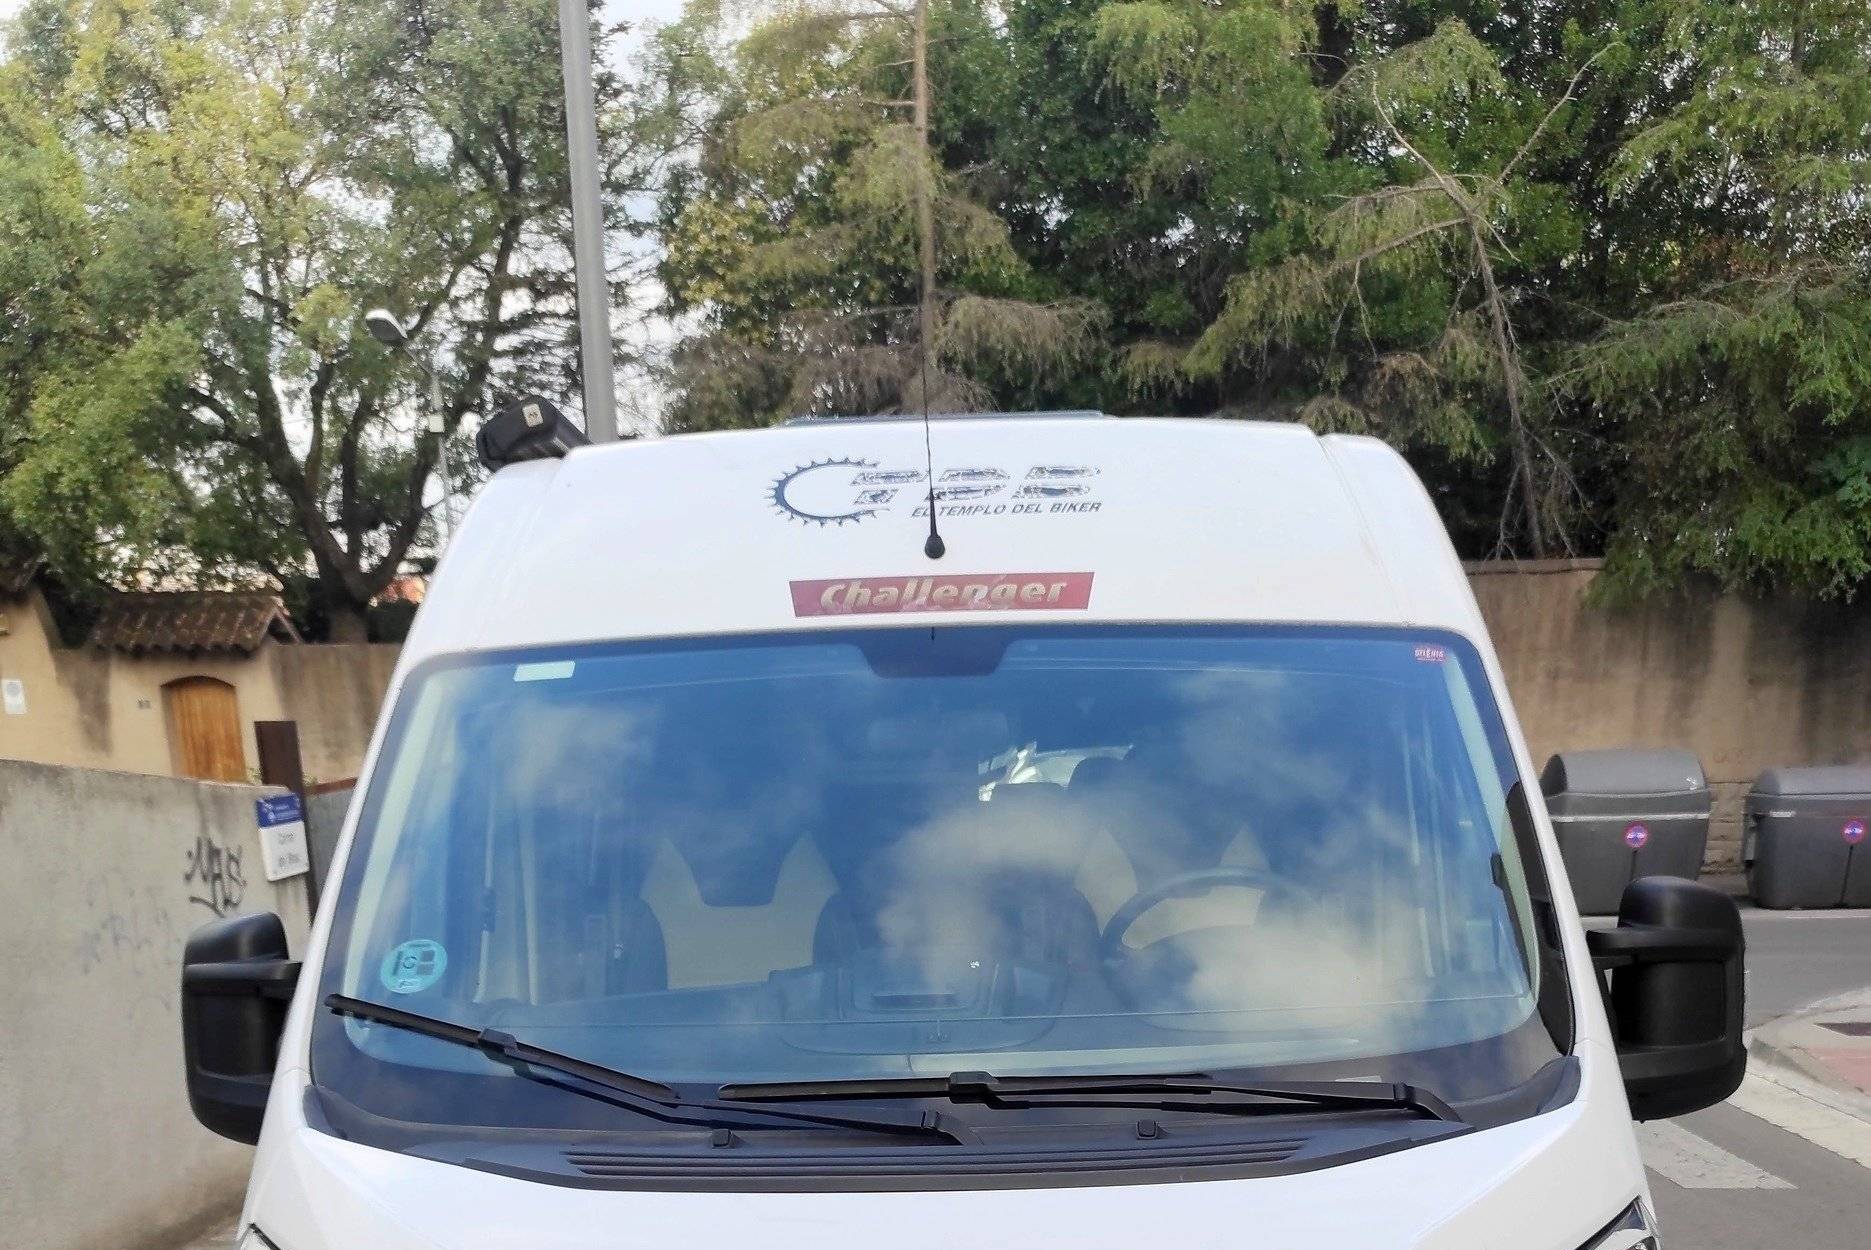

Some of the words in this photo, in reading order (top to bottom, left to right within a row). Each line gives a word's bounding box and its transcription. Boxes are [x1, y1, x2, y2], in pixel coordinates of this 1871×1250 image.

[938, 504, 1007, 517] TEMPLO
[1011, 502, 1043, 514] DEL
[1050, 501, 1103, 514] BIKER
[820, 574, 1069, 611] Challenger
